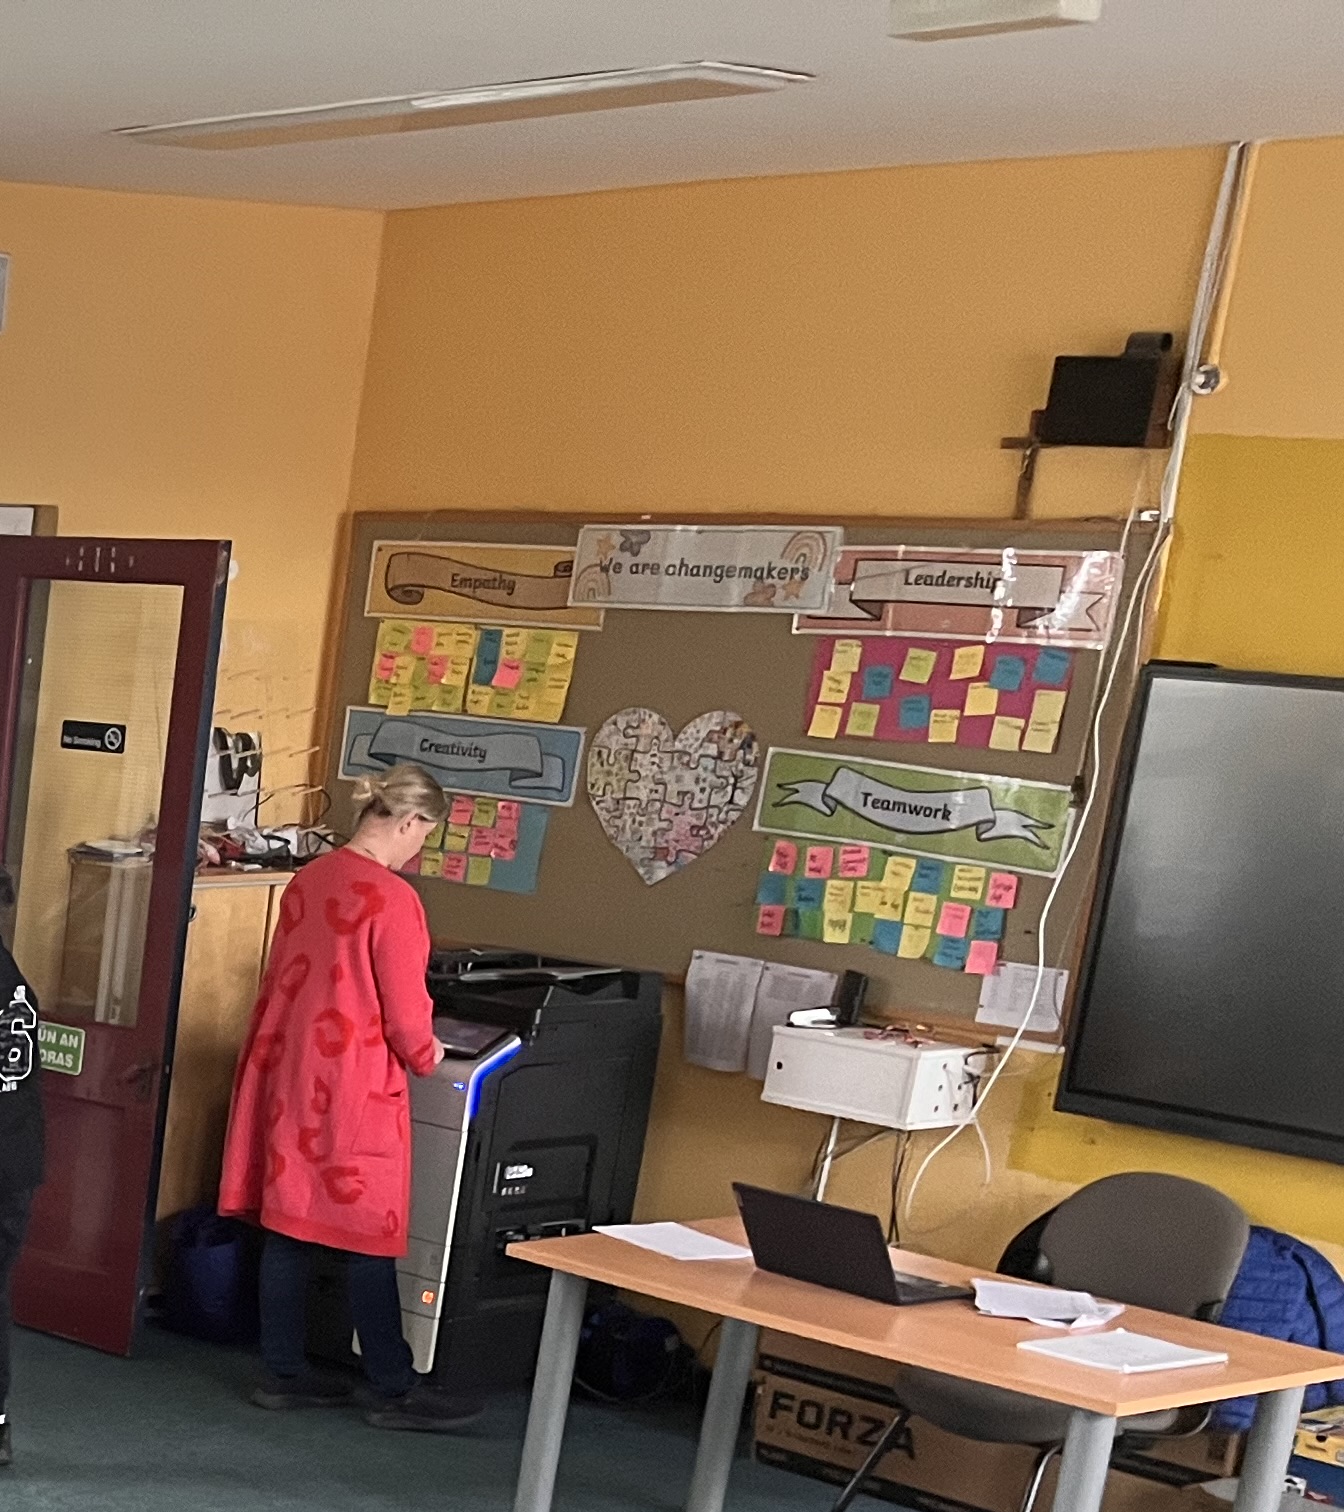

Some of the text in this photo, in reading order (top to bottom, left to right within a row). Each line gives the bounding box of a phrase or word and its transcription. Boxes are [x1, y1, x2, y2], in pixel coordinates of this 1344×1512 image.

[599, 557, 810, 583] We are changemakers
[450, 573, 517, 596] Empathy
[419, 738, 487, 764] Creativity
[861, 791, 952, 822] Teamwork
[37, 1025, 79, 1049] ÚN AN
[39, 1048, 74, 1068] ORAS
[768, 1390, 916, 1460] FORZA
